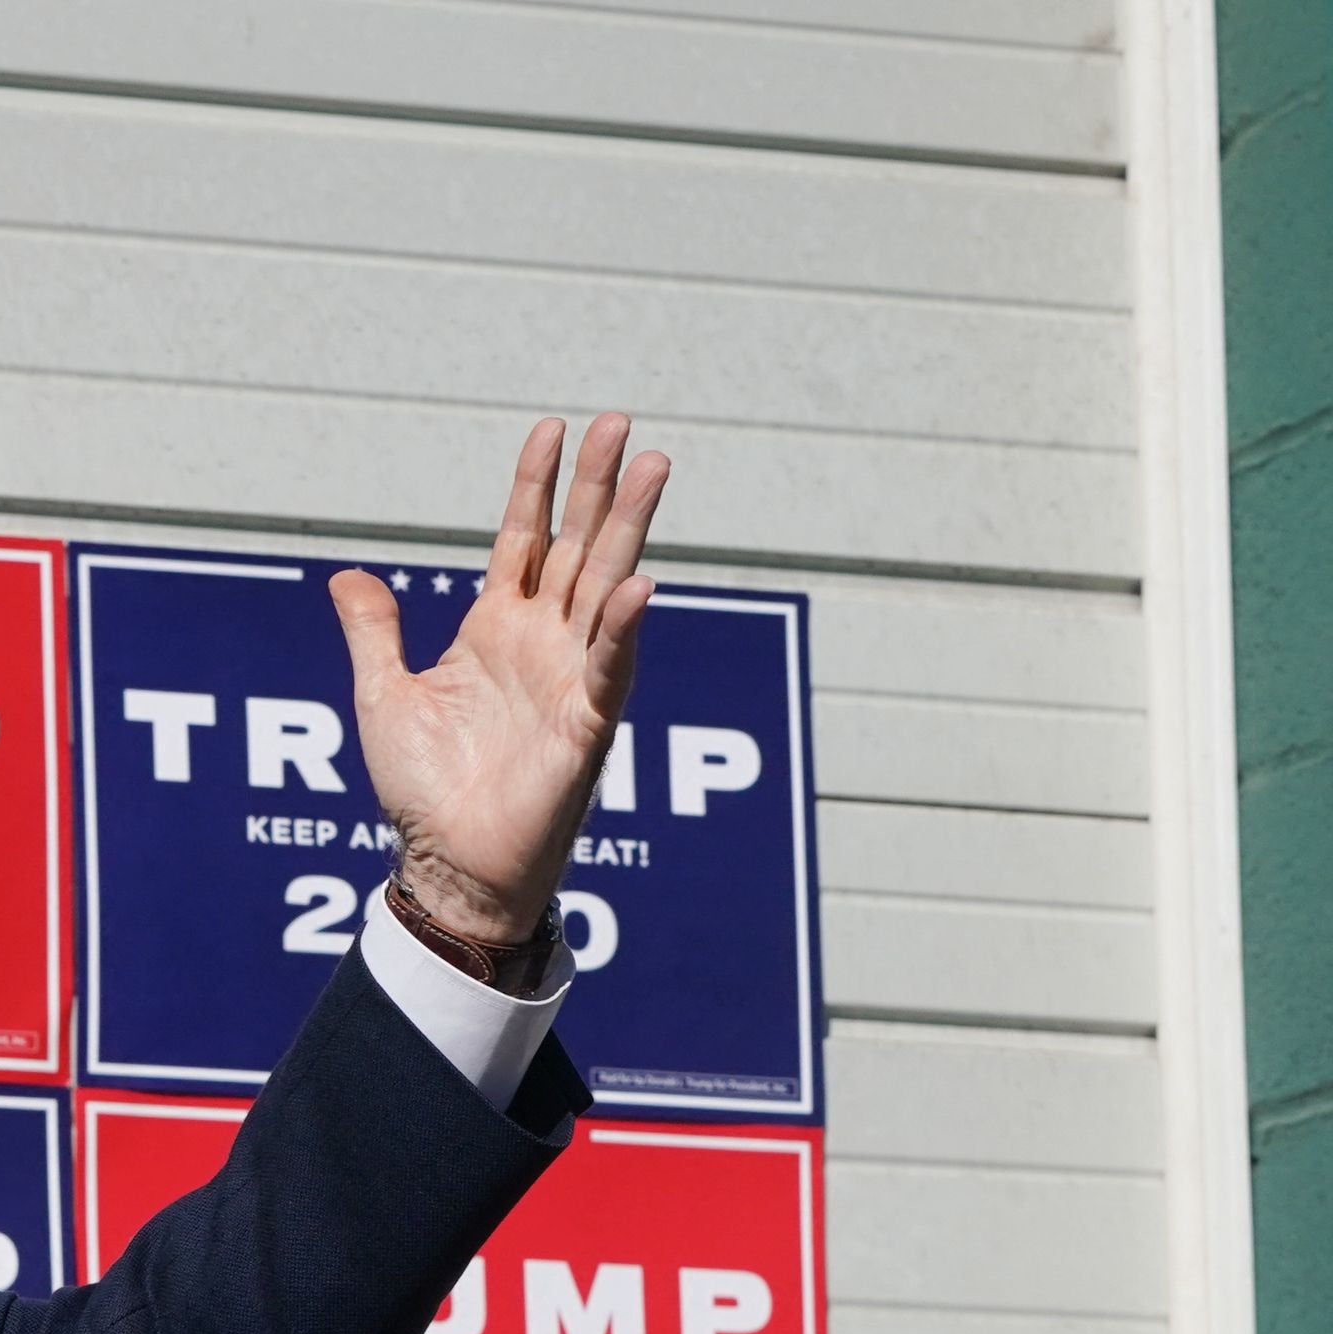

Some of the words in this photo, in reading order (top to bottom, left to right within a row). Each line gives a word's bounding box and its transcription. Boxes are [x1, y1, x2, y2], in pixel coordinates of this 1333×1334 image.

[123, 689, 763, 817] TRP
[246, 815, 338, 847] KEEP
[572, 837, 650, 868] EAT!
